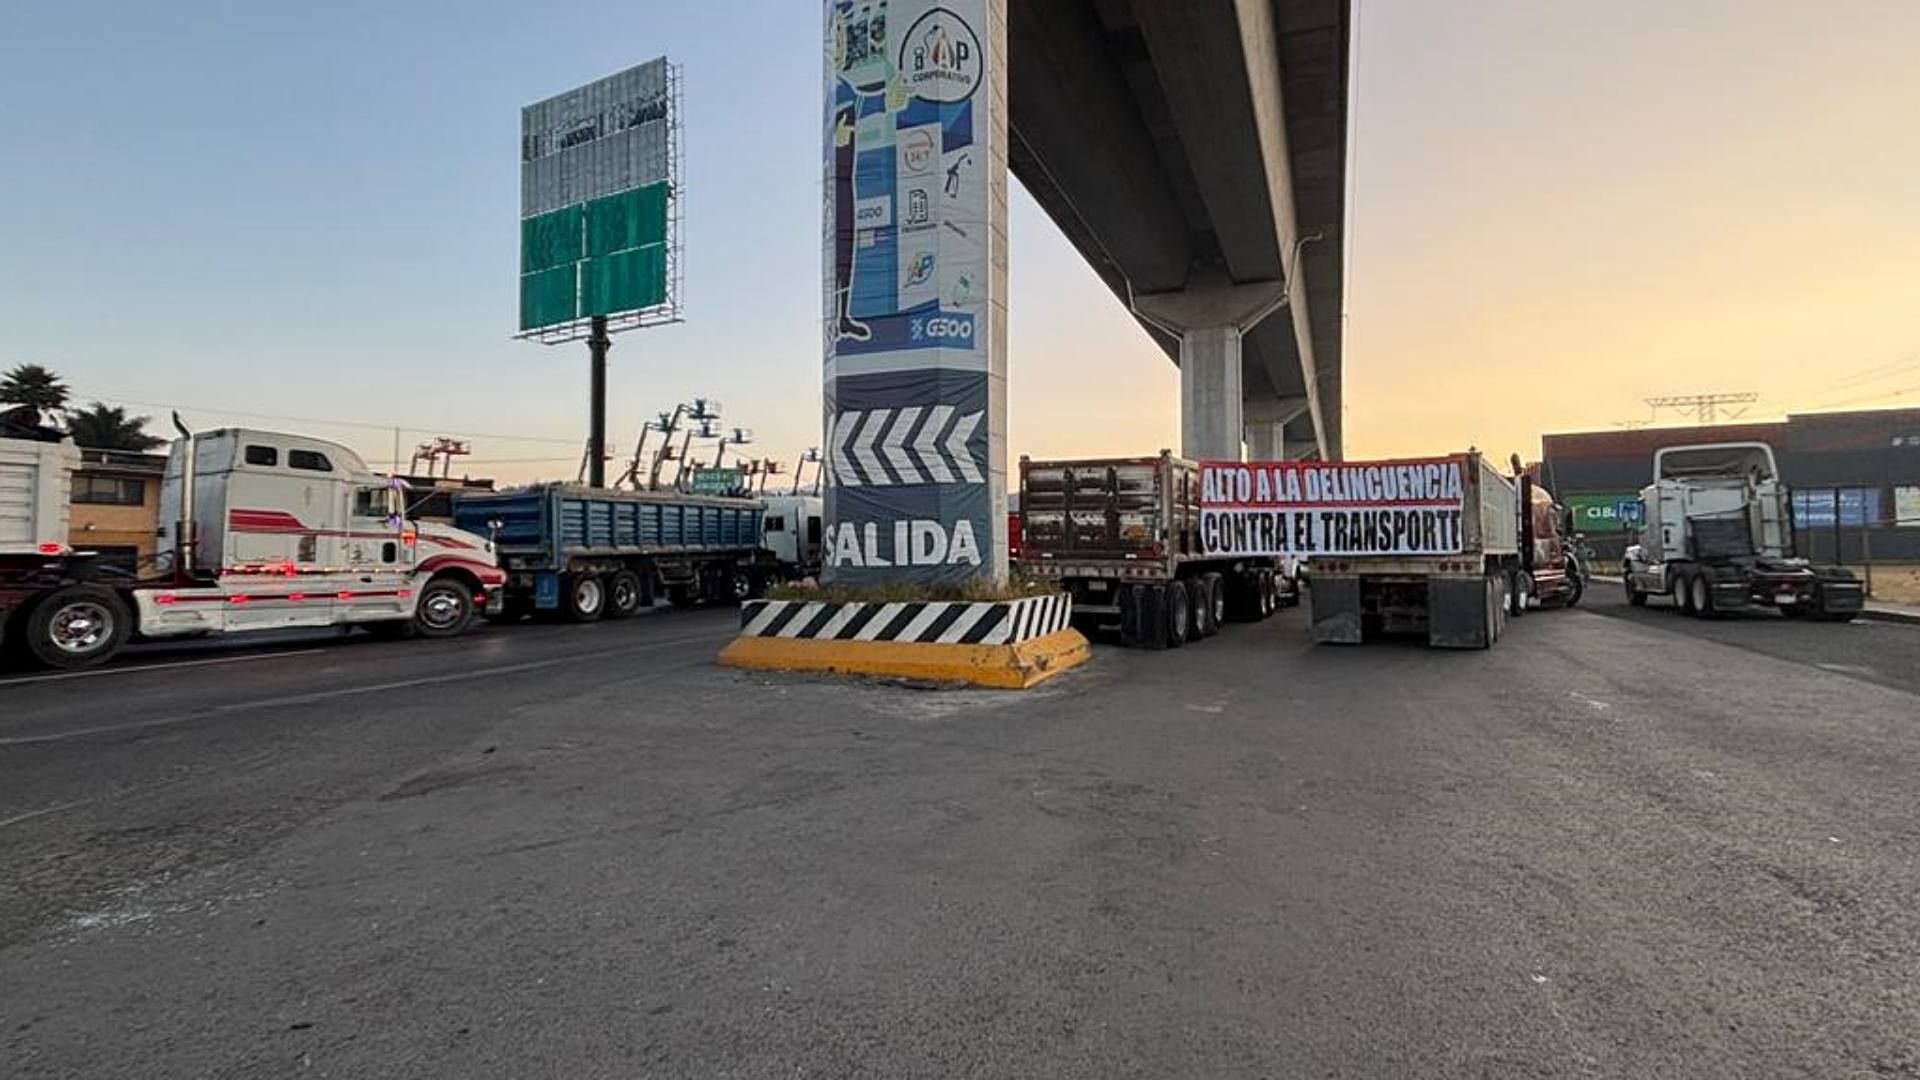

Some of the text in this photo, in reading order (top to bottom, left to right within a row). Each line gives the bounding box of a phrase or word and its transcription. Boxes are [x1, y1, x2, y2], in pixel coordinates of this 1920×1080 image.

[926, 318, 972, 338] G500
[1203, 463, 1463, 503] ALTO A LA DELINCUENCIA
[824, 519, 982, 568] SALIDA
[1204, 509, 1460, 553] CONTRA EL TRANSPORTE
